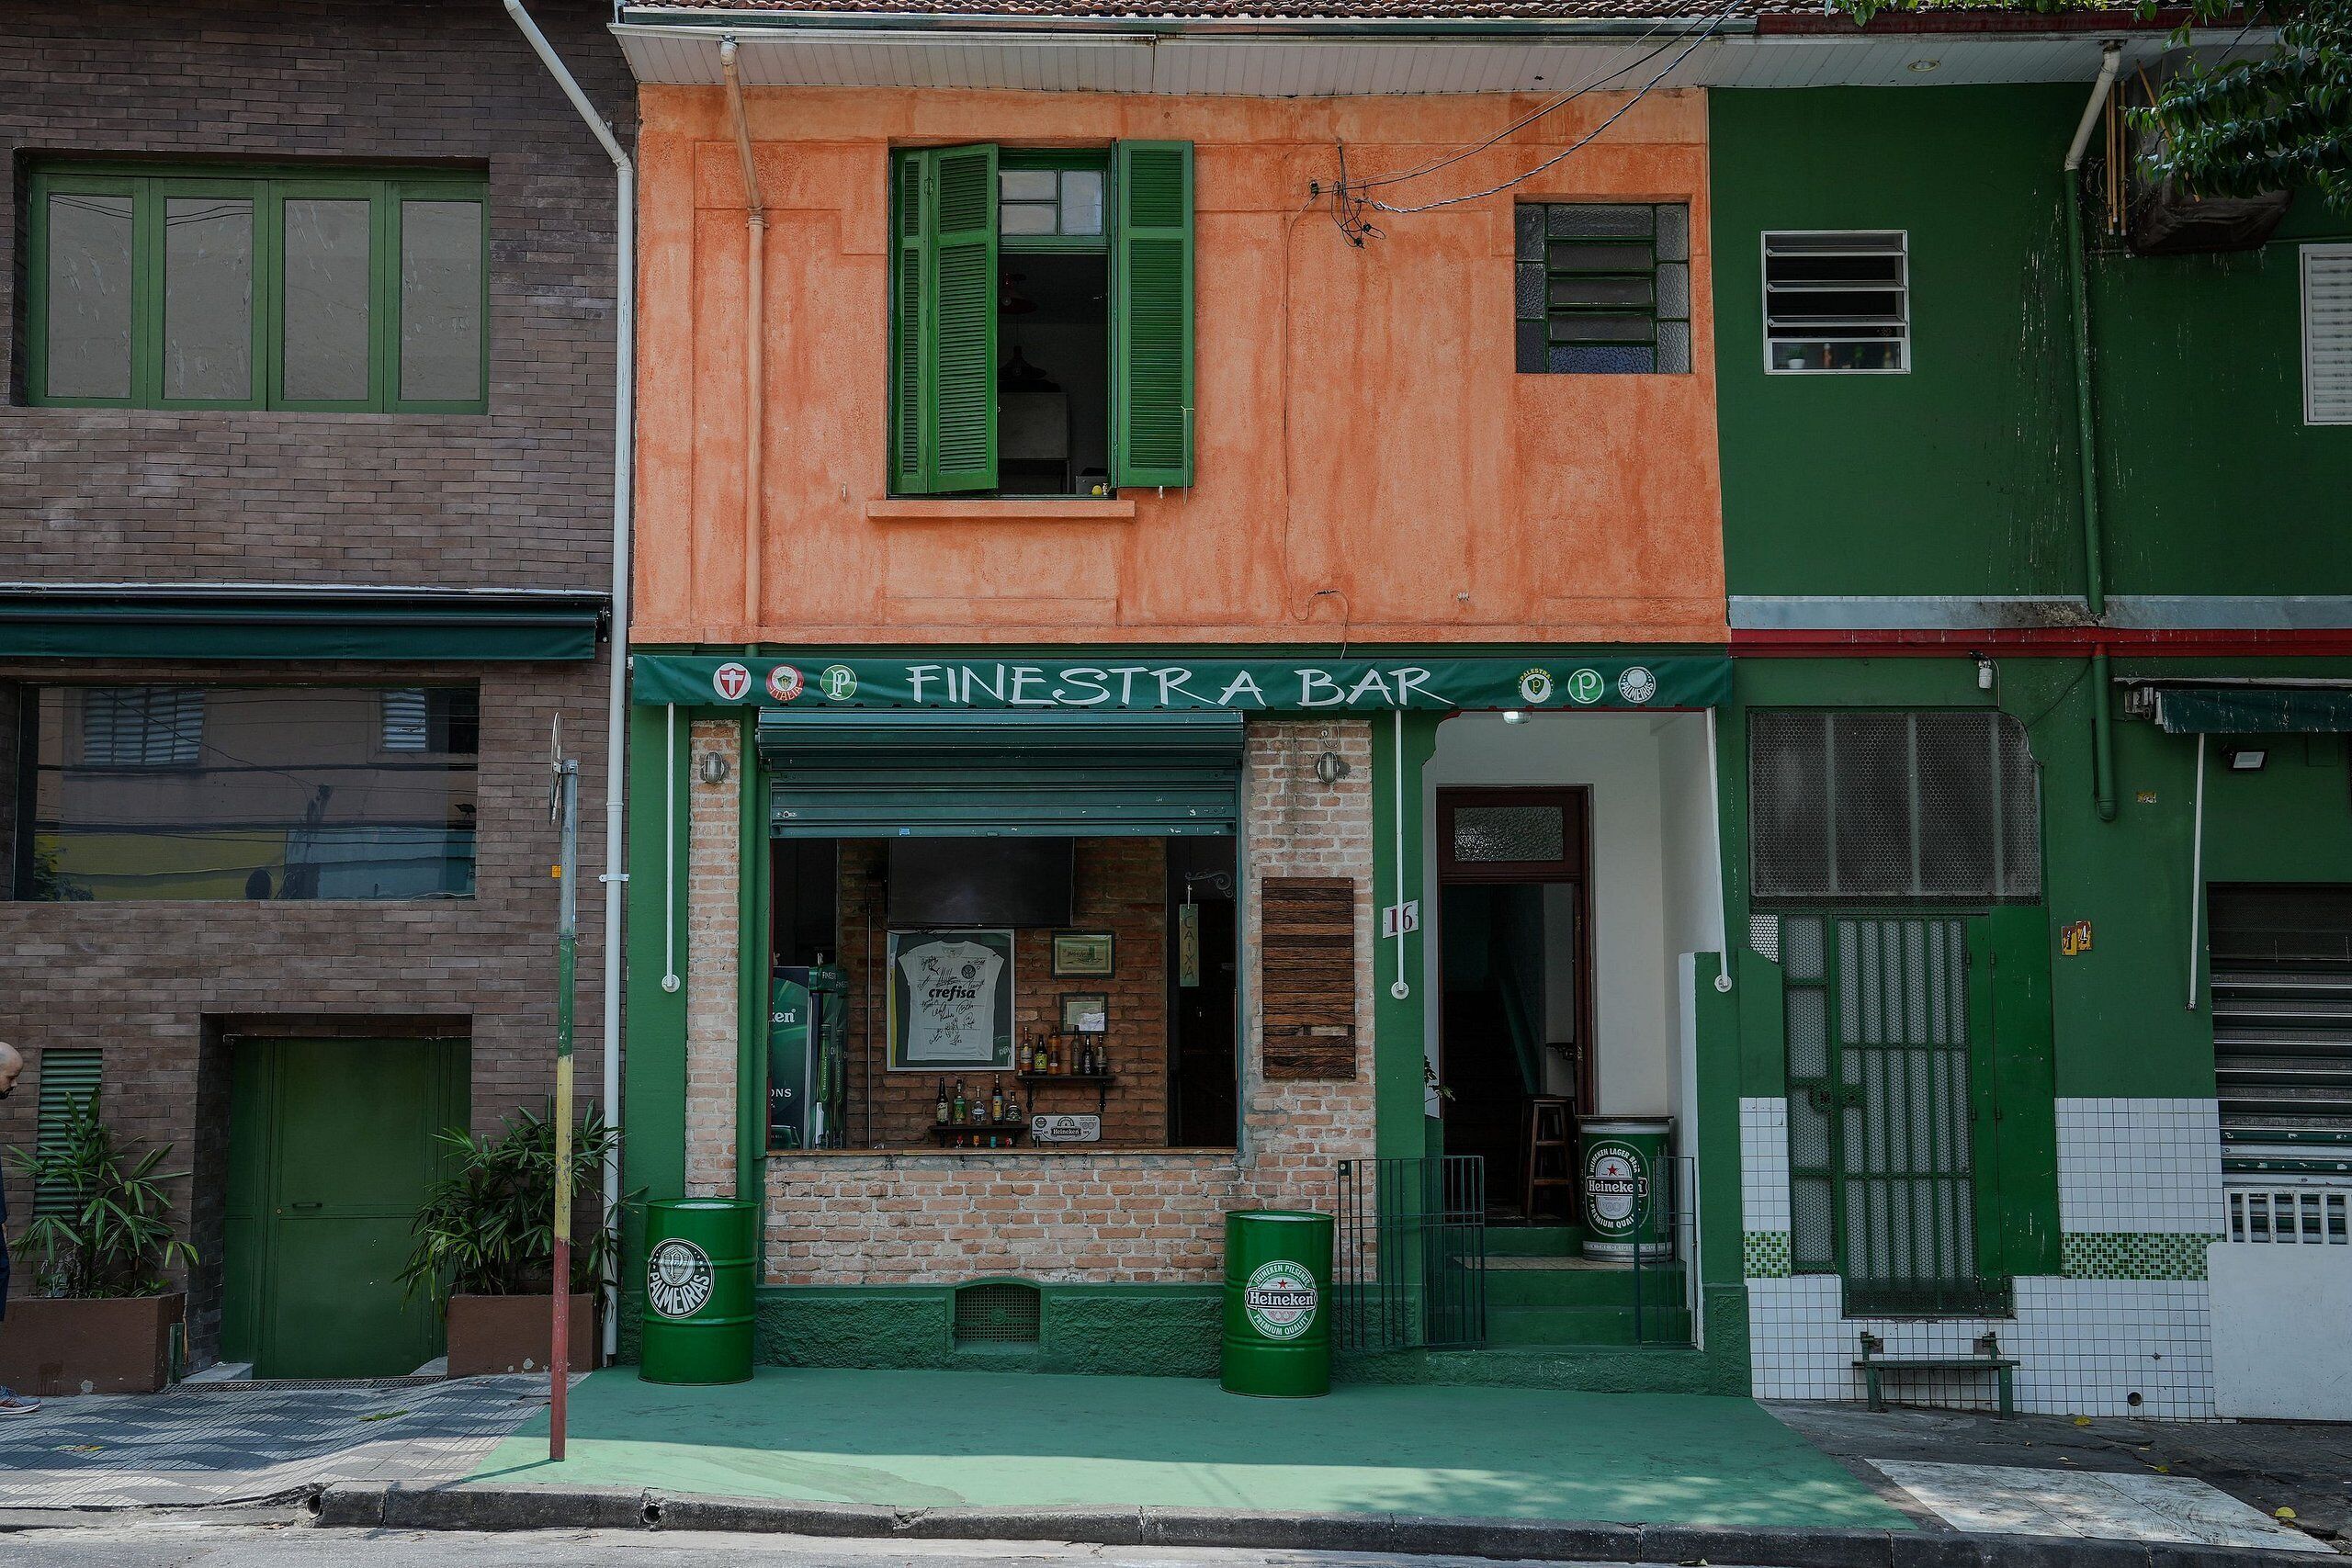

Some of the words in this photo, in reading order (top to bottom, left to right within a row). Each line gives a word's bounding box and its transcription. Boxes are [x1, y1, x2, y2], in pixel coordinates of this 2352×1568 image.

[1520, 667, 1552, 682] PALESTRA
[770, 684, 803, 701] ITALIA
[1294, 666, 1455, 706] BAR
[1621, 682, 1655, 701] PALMEIRAS
[1388, 904, 1413, 933] 16
[1184, 915, 1195, 979] CAIXA
[928, 985, 976, 1002] crefisa
[1609, 1147, 1631, 1159] LAGER
[1589, 1203, 1614, 1228] PREMIUM
[1253, 1264, 1283, 1285] HEINEKEN
[1284, 1264, 1311, 1286] PILSENER
[650, 1271, 710, 1314] PALMEIRAS
[1250, 1291, 1314, 1305] Heineken
[1253, 1314, 1283, 1336] PREMIUM
[1284, 1314, 1310, 1335] QUALITY
